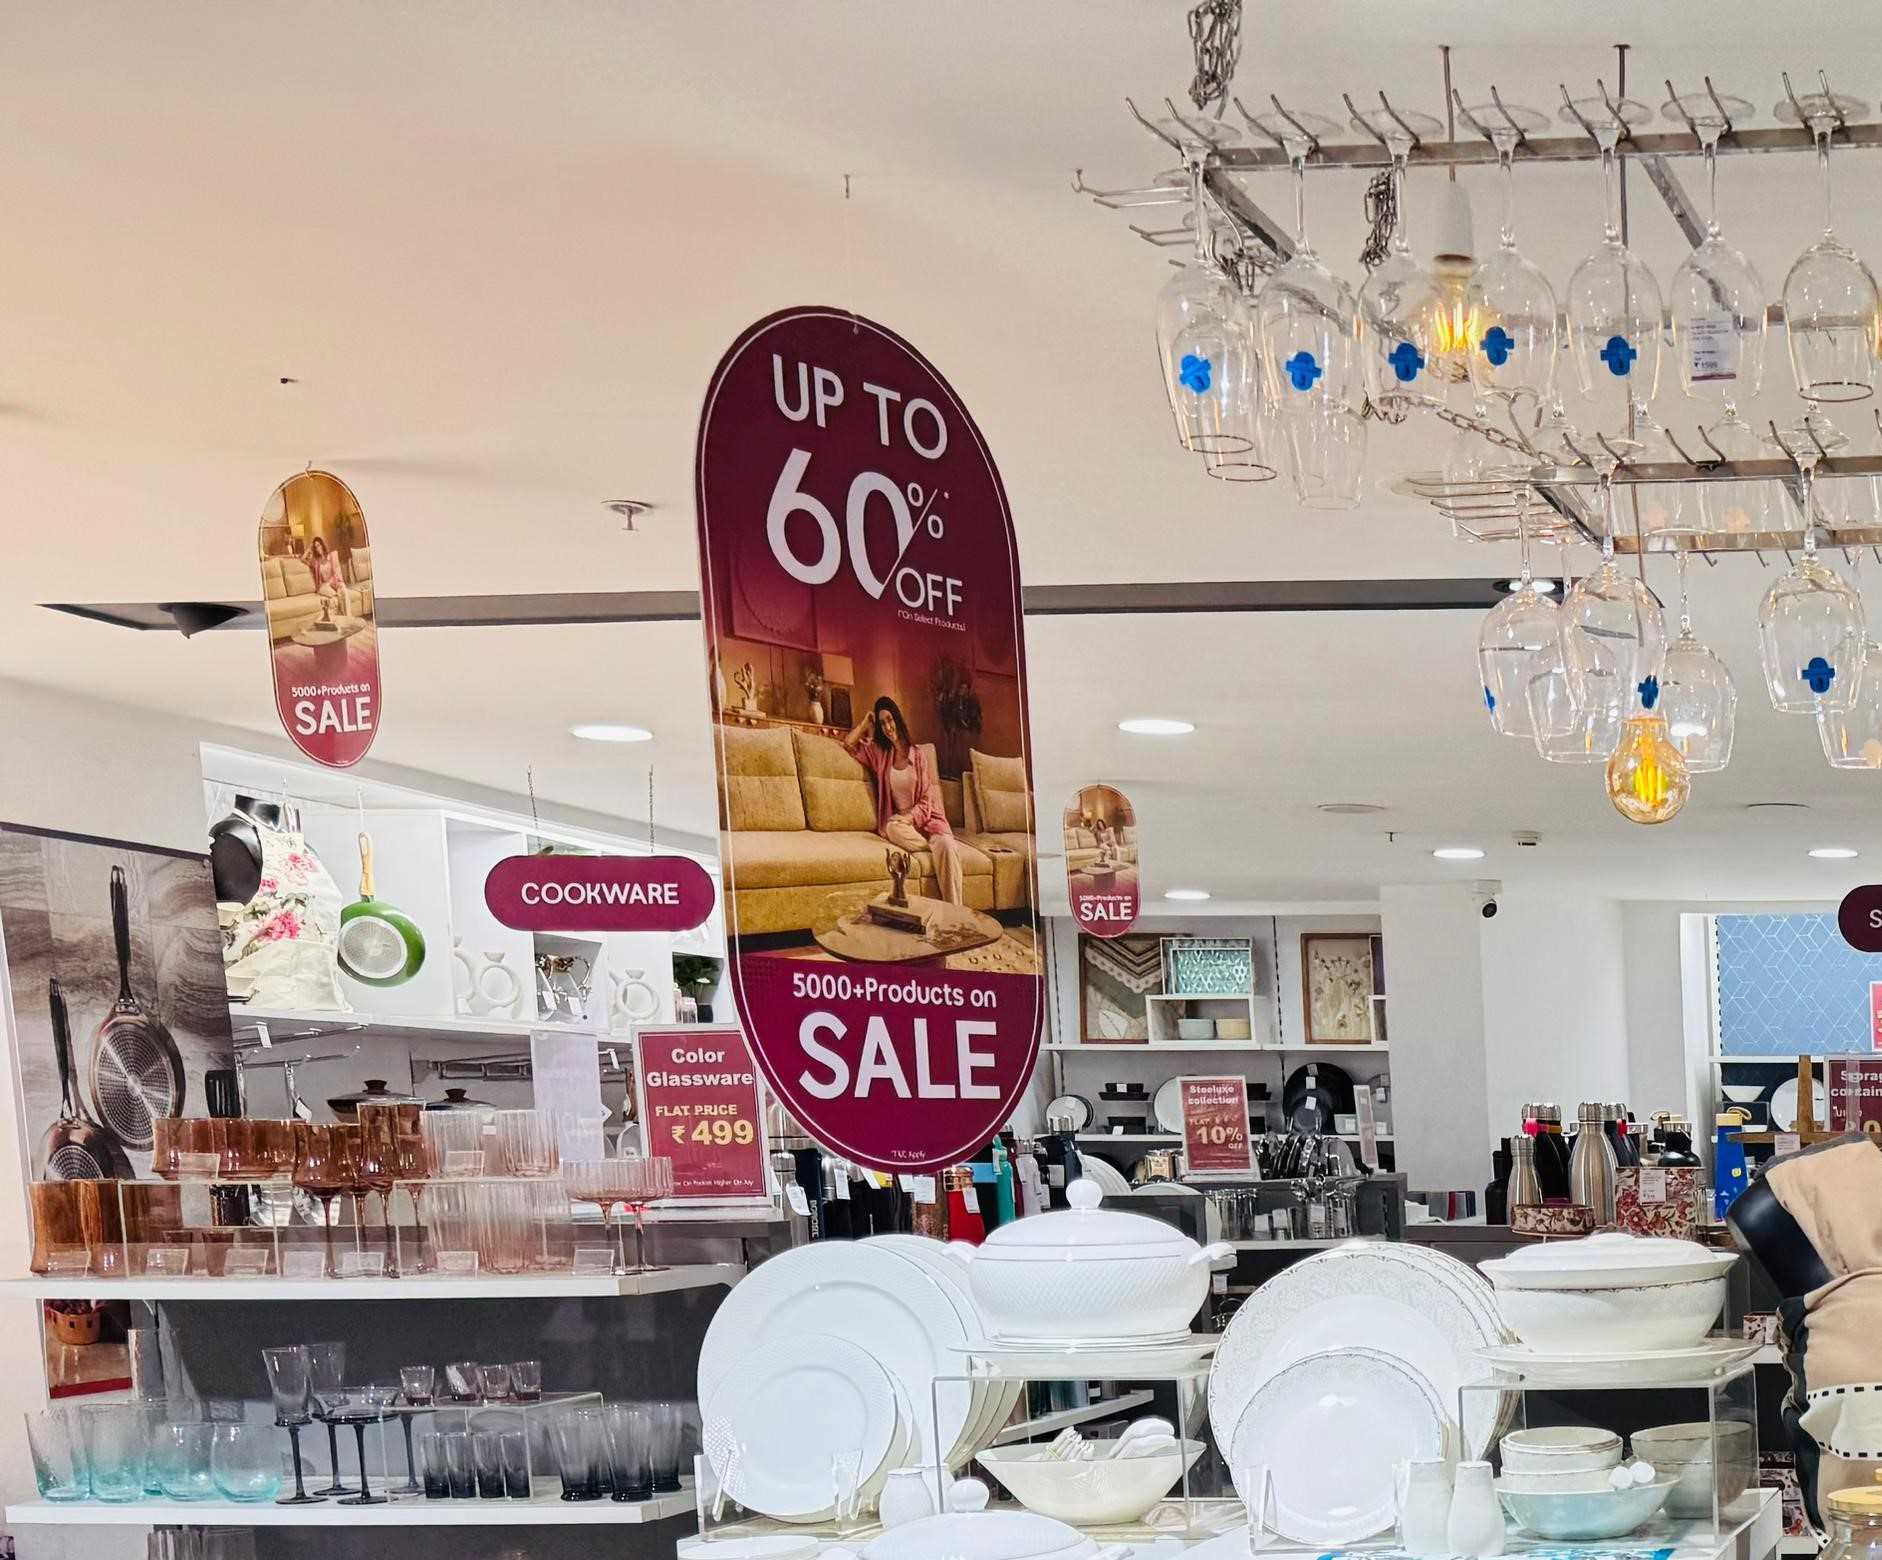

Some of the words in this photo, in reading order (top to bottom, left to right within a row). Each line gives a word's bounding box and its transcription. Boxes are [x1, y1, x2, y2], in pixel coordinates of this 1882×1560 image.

[773, 354, 844, 428] UP
[863, 382, 948, 460] TO
[896, 567, 963, 616] OFF
[295, 696, 372, 736] SALE
[520, 881, 680, 906] COOKWARE
[1080, 902, 1133, 921] SALE
[792, 972, 964, 1007] 5000+Products
[970, 989, 997, 1009] on
[671, 1048, 726, 1064] Color
[798, 1011, 1001, 1100] SALE
[646, 1071, 754, 1088] Glassware
[655, 1105, 690, 1117] FLAT
[694, 1104, 738, 1116] PRICE
[691, 1119, 754, 1146] 499
[1196, 1125, 1243, 1145] 10%
